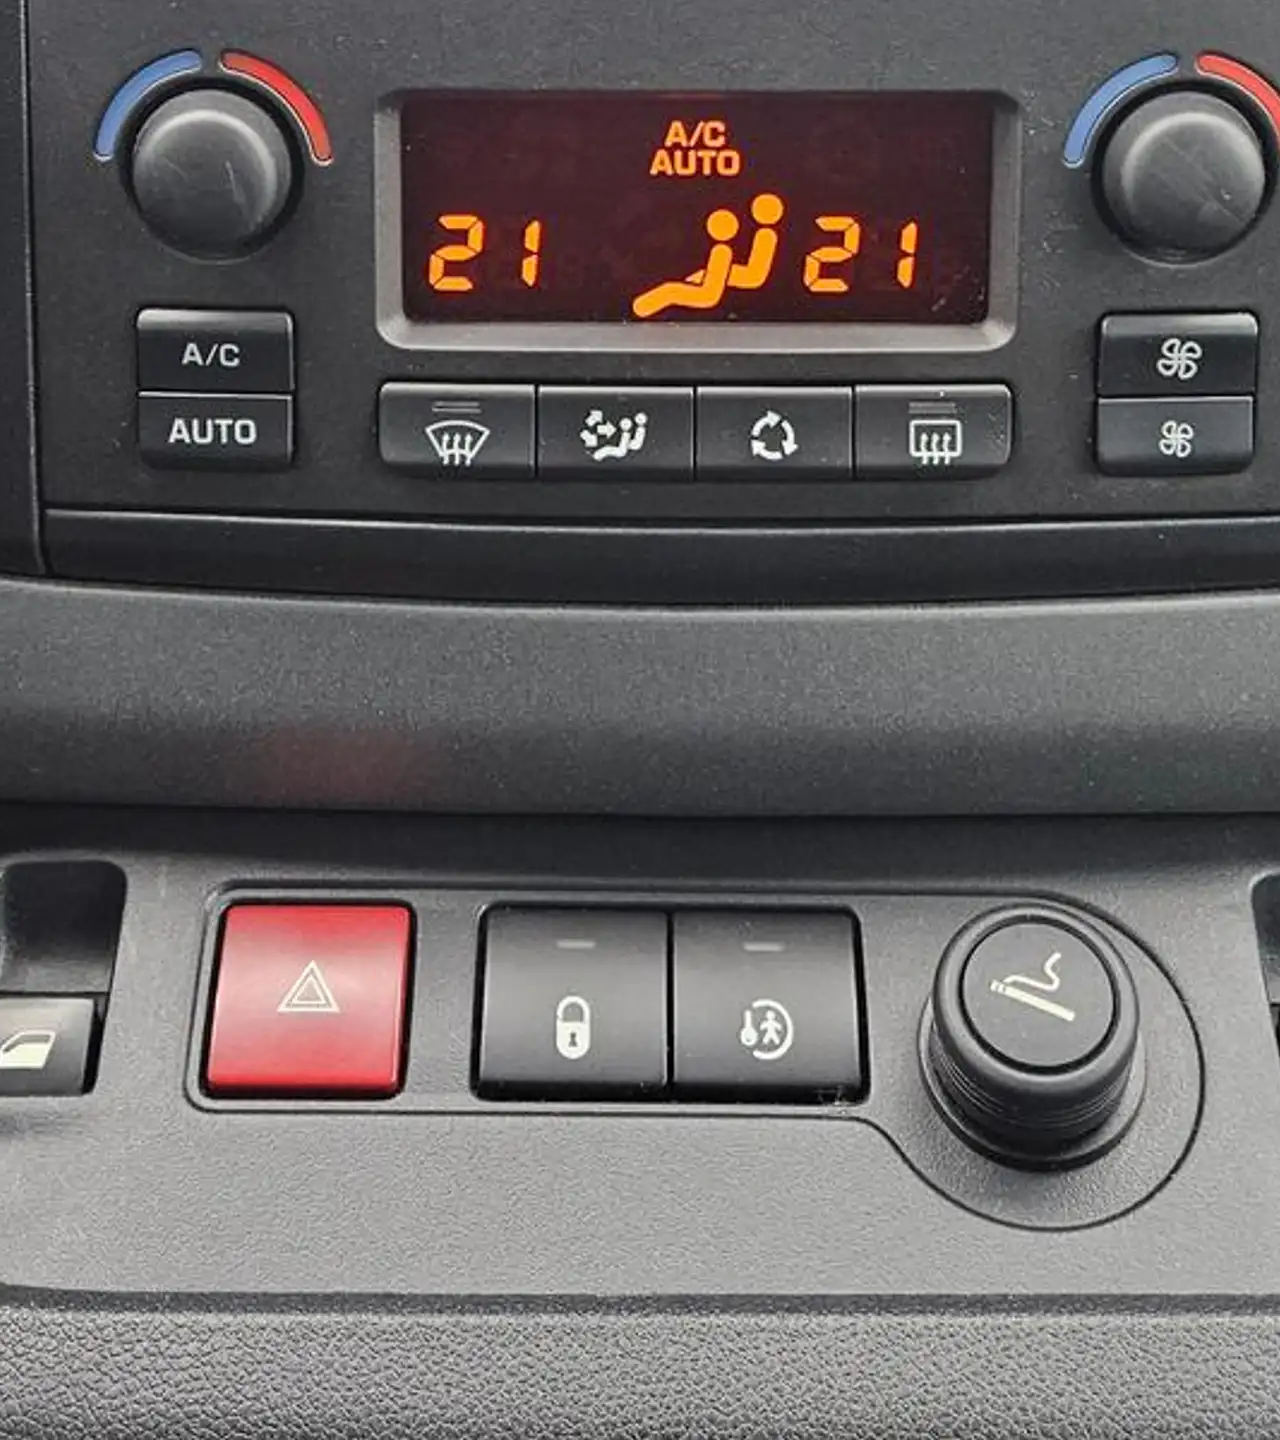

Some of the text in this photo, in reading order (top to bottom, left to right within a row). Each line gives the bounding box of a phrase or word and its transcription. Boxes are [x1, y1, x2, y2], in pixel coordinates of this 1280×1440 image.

[664, 121, 726, 148] A/C
[649, 148, 741, 176] AUTO
[428, 214, 541, 292] 21
[803, 215, 919, 292] 21
[181, 342, 241, 368] A/C
[168, 418, 258, 446] AUTO
